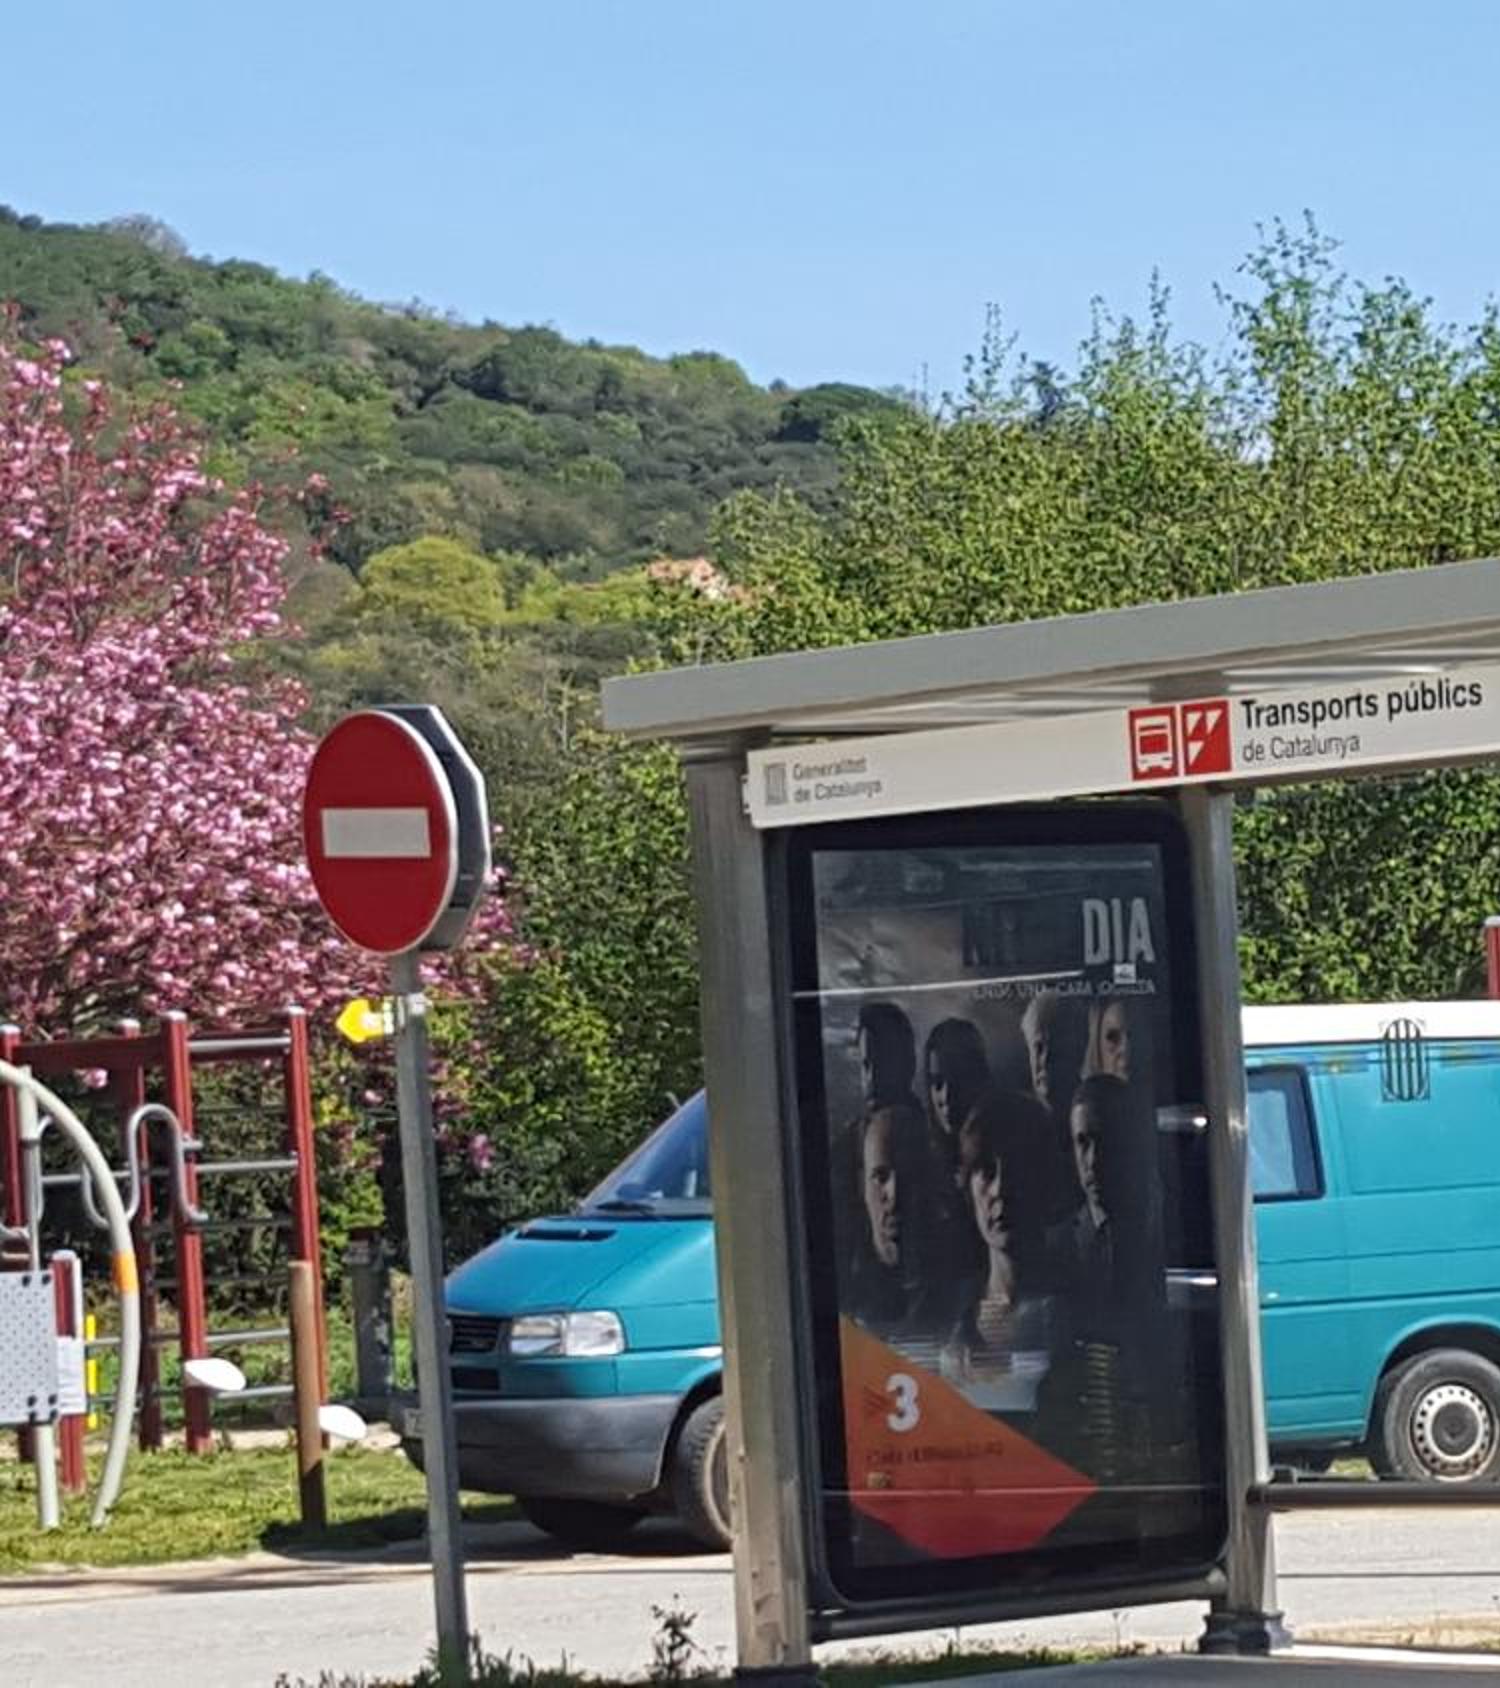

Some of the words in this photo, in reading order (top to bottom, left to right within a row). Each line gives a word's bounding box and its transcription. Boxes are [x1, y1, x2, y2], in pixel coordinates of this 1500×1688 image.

[1241, 692, 1379, 729] Transports
[1387, 678, 1483, 723] públics
[1242, 742, 1266, 763] de
[1270, 735, 1361, 759] Catalunya
[1083, 897, 1156, 966] DIA
[885, 1373, 921, 1432] 3
